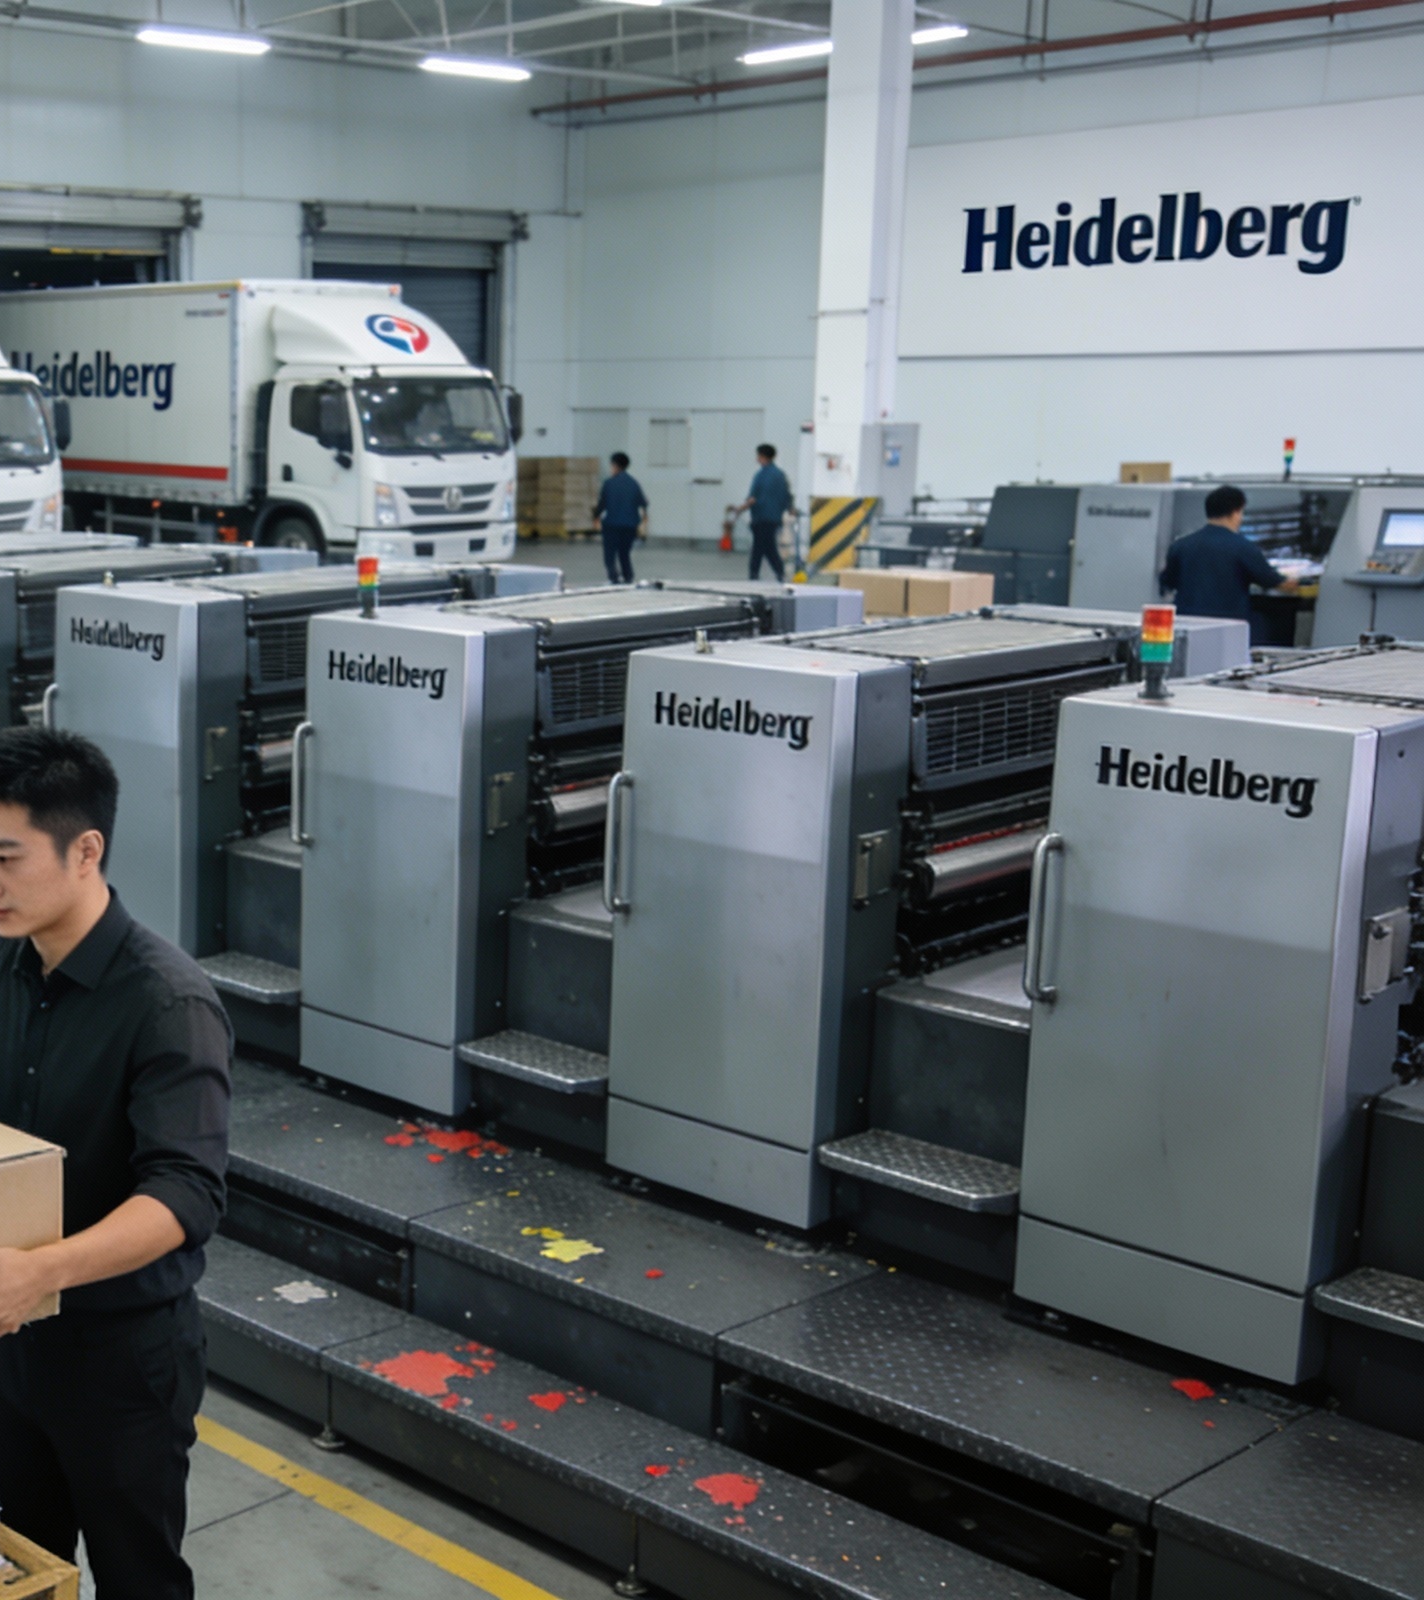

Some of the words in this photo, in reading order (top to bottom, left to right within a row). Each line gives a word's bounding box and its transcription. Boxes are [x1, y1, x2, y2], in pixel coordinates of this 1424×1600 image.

[962, 191, 1351, 275] Heidelberg
[329, 649, 447, 700] Heidelberg
[655, 691, 814, 751] Heidelberg
[1097, 745, 1320, 819] Heidelberg
